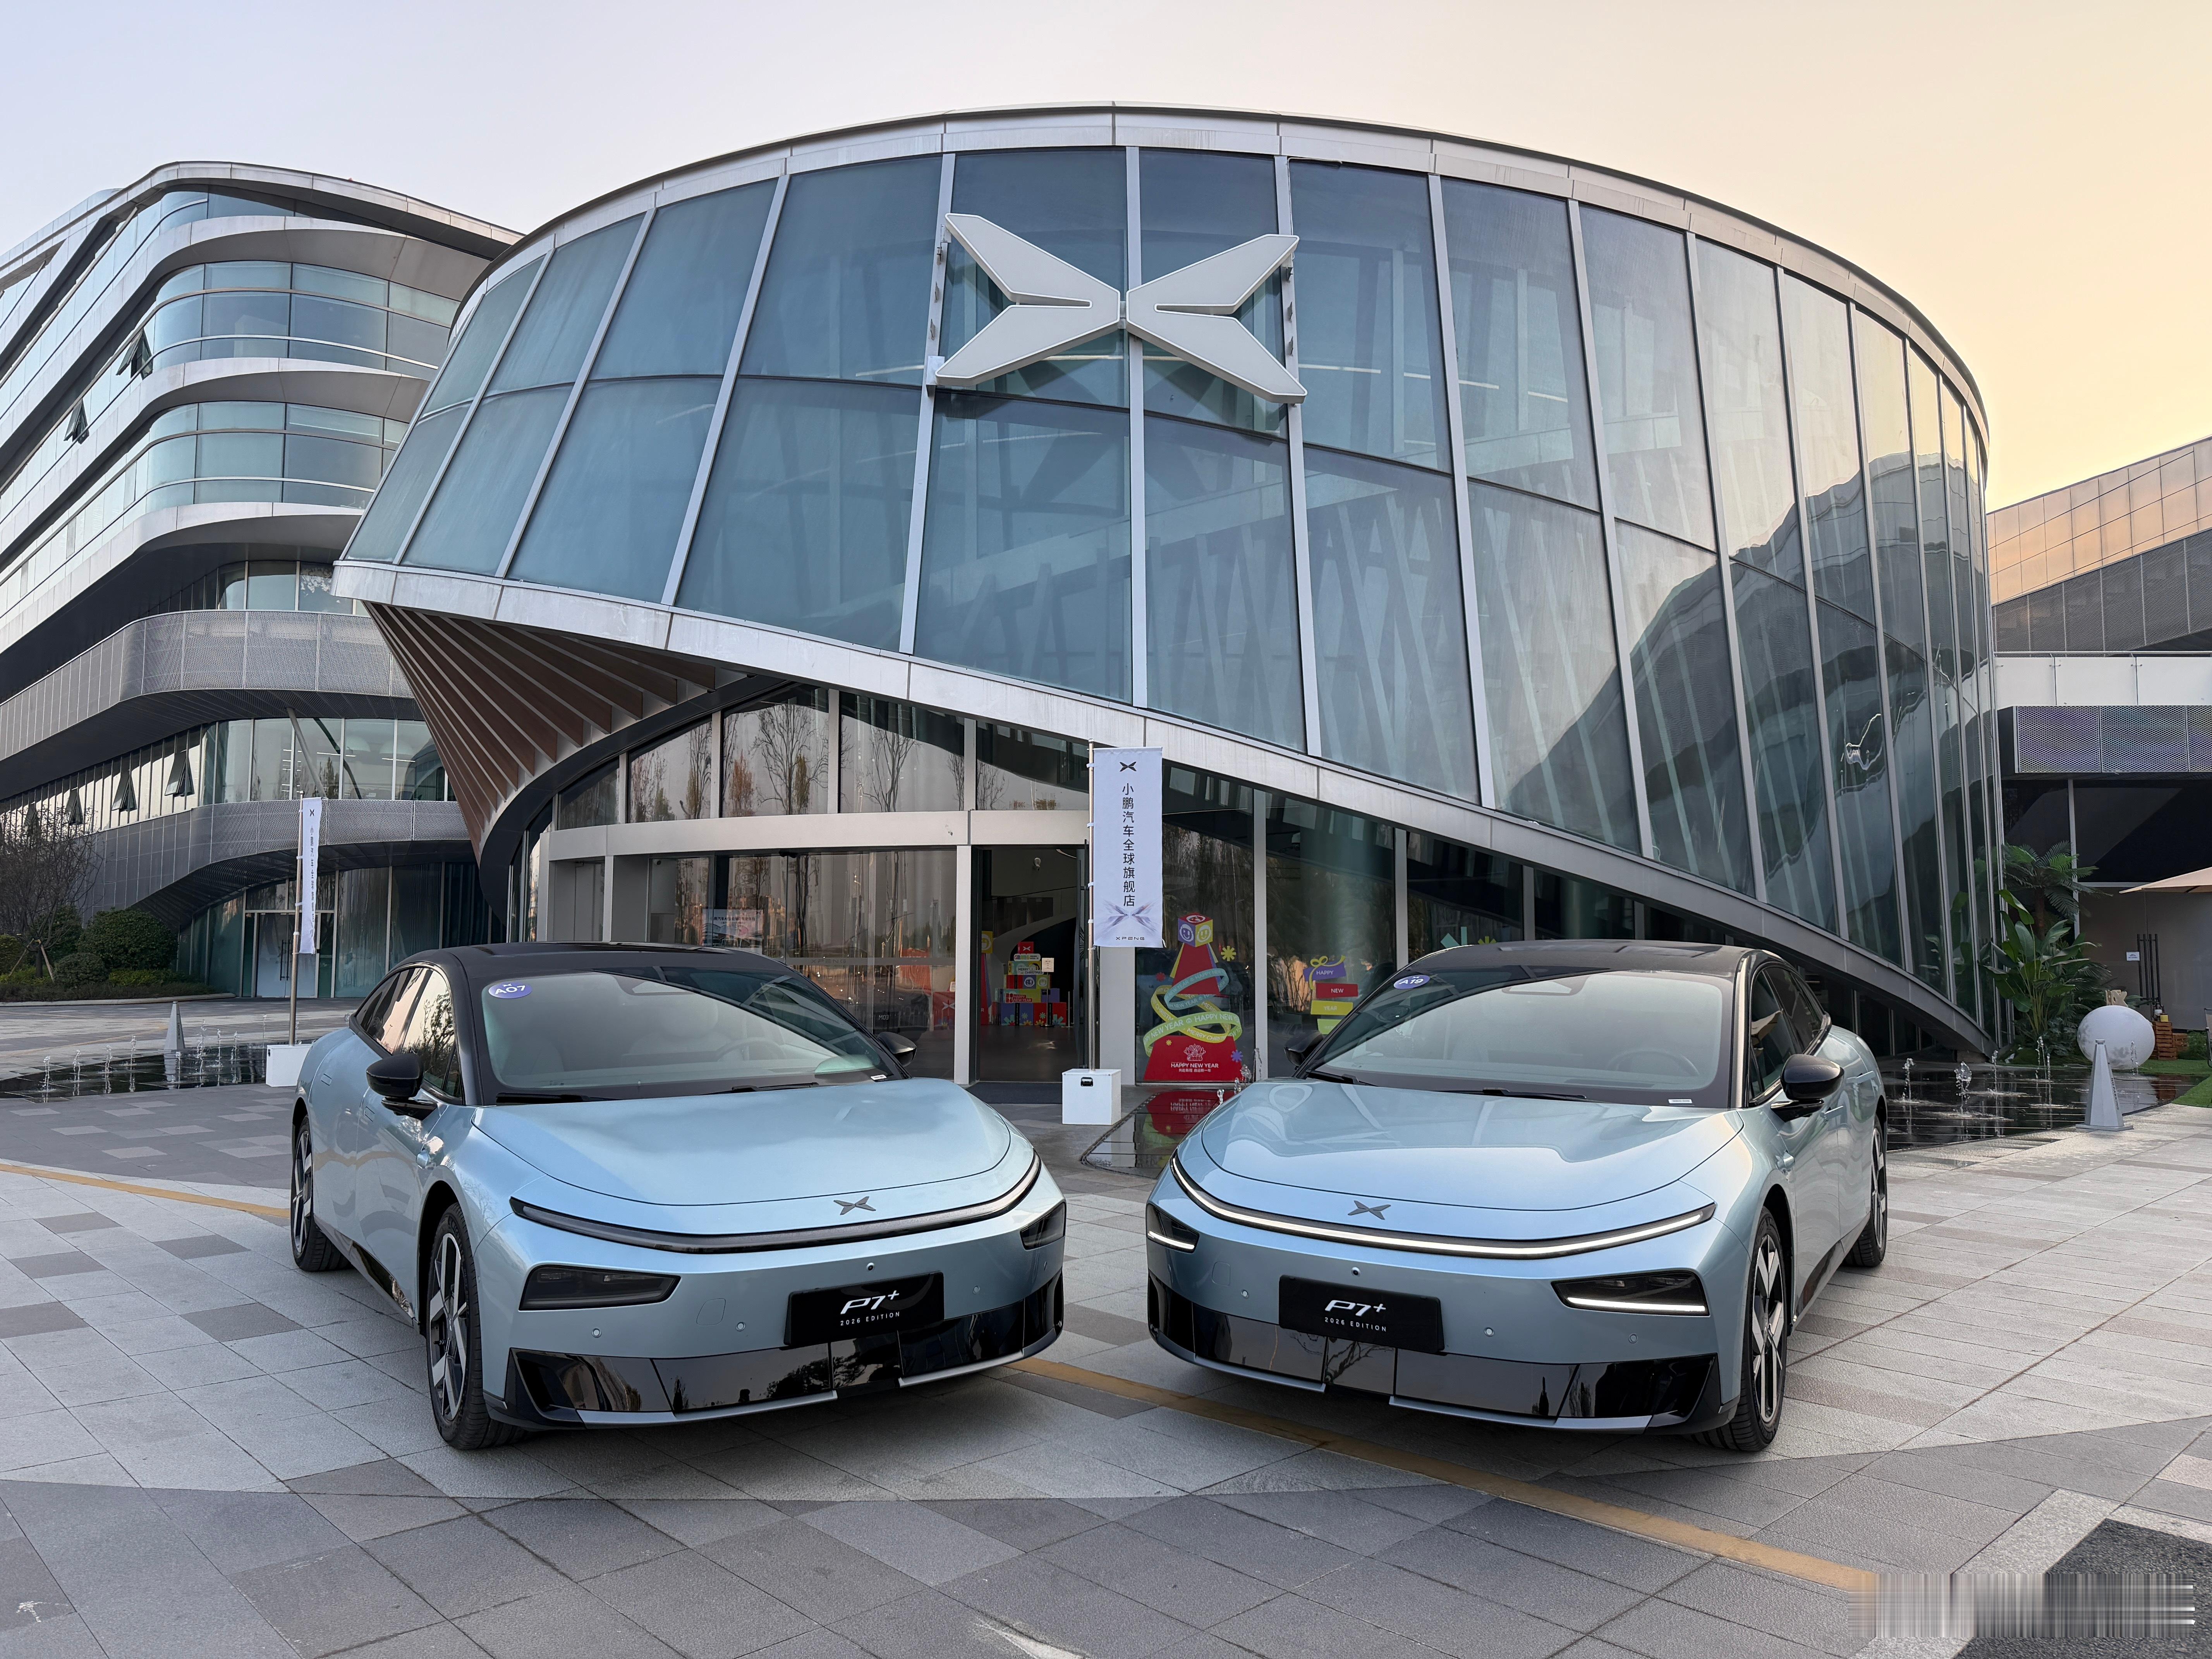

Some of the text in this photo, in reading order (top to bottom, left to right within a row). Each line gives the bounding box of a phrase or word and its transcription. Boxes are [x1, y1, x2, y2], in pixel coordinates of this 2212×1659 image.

[1122, 783, 1135, 907] 小鹏汽车全球旗舰店
[1151, 1027, 1164, 1037] NEW
[1164, 1019, 1184, 1031] YEAR
[1194, 1013, 1218, 1023] HAPPY
[1187, 1028, 1206, 1039] MERRY
[840, 1311, 900, 1326] 2026 EDITION
[1324, 1317, 1387, 1332] 2026 EDITION
